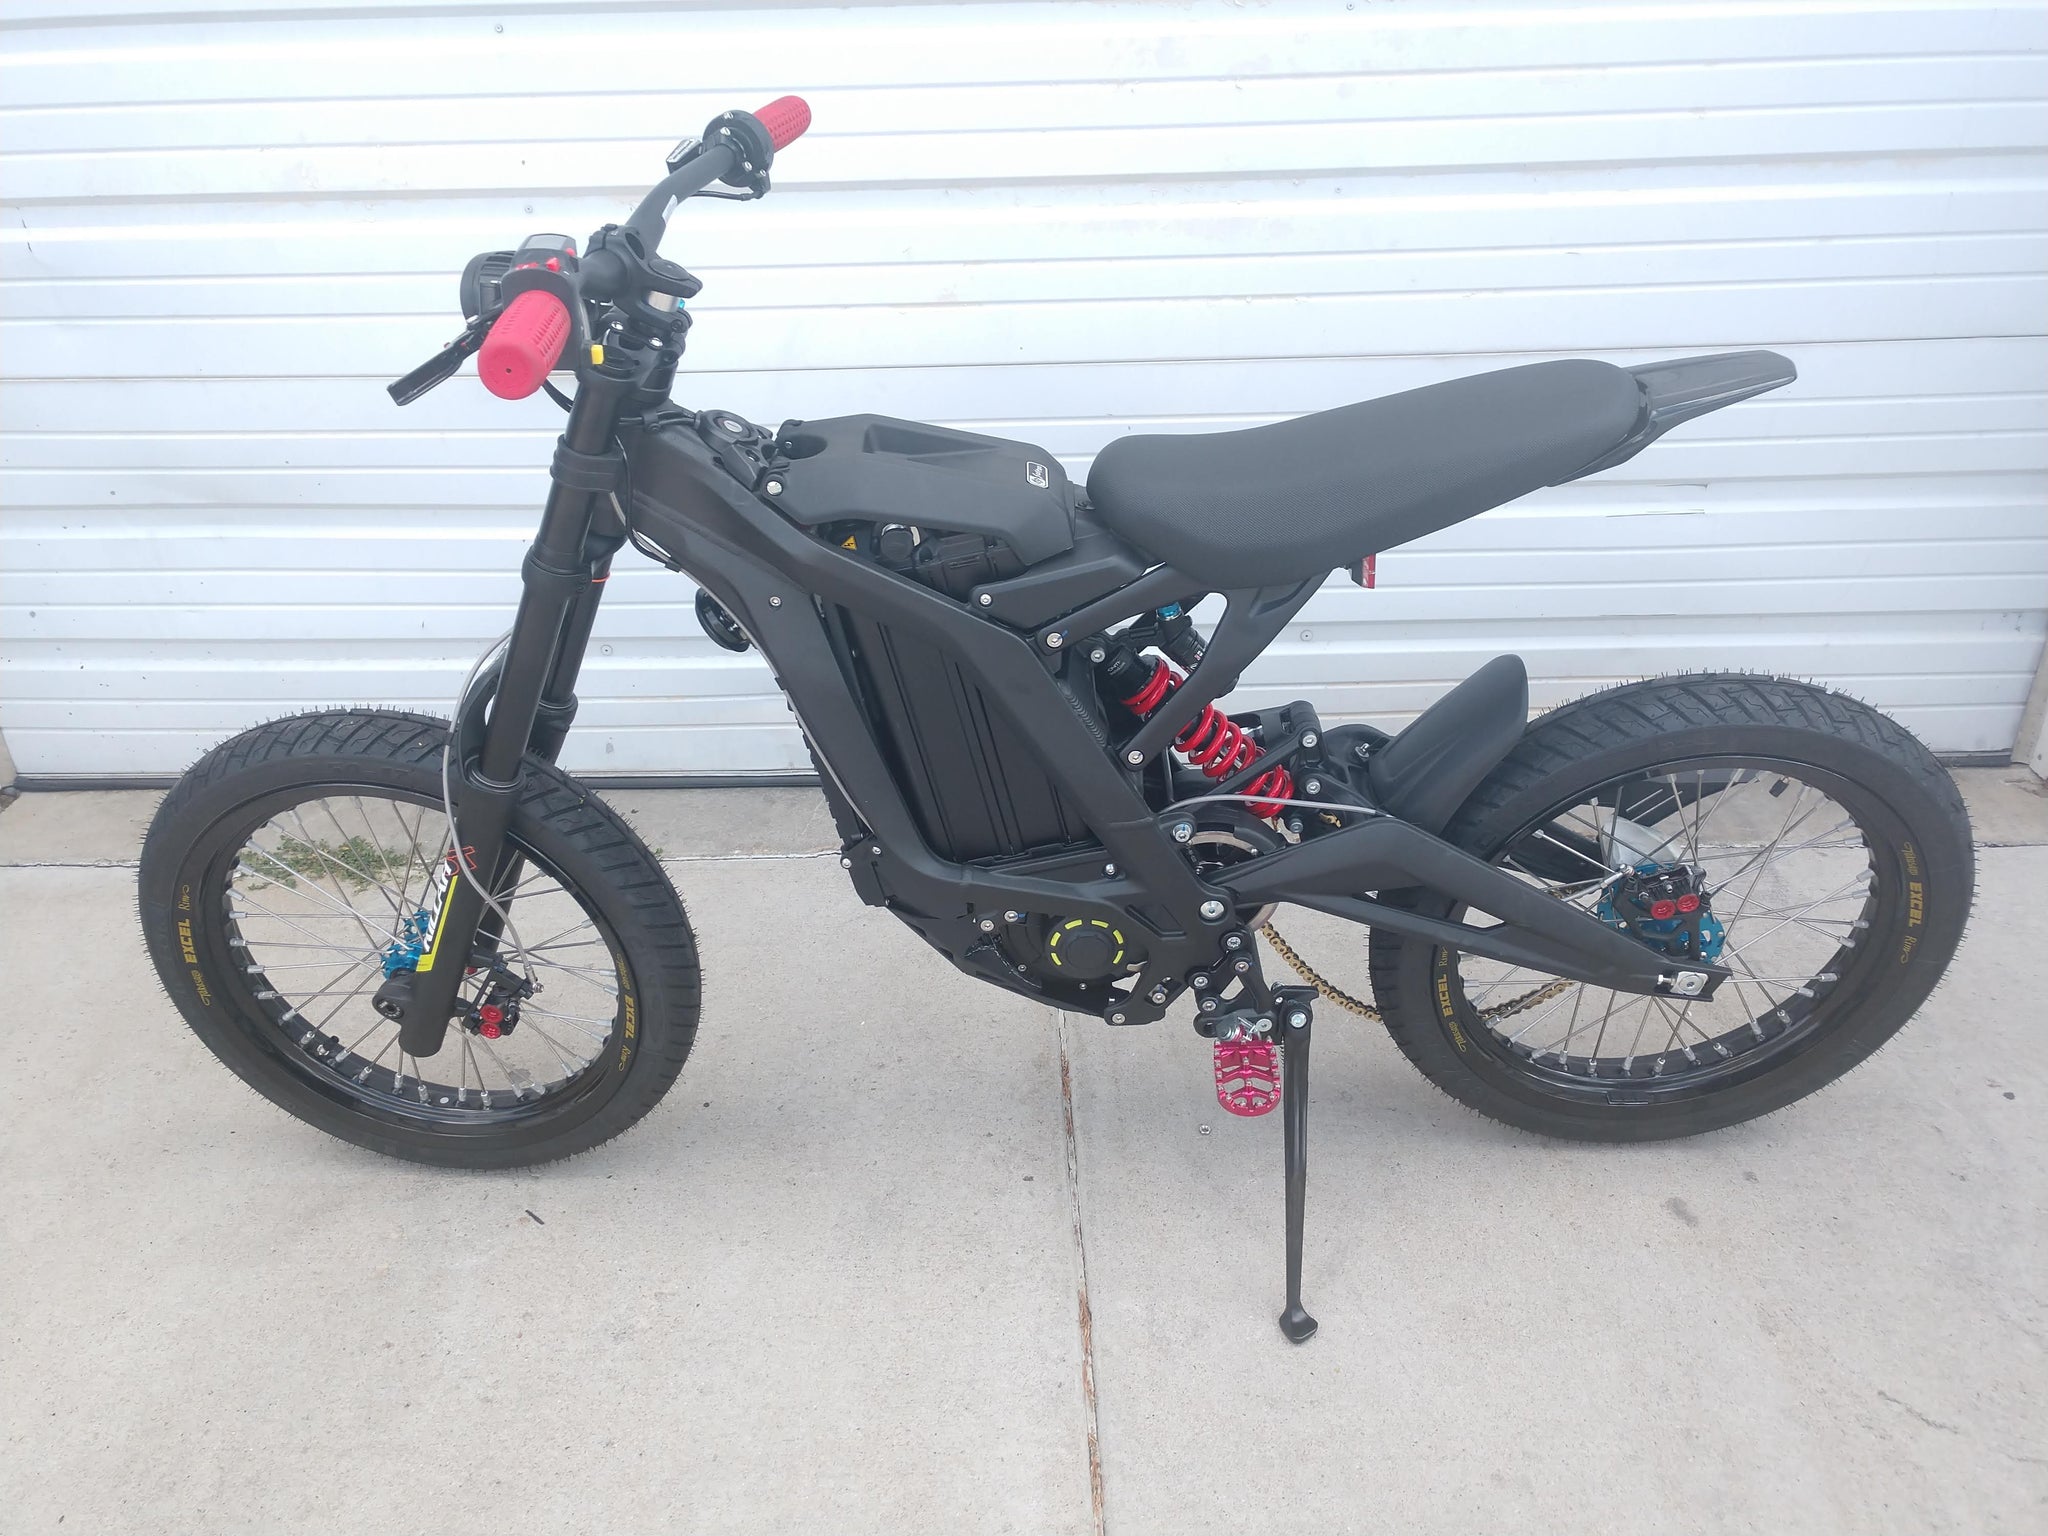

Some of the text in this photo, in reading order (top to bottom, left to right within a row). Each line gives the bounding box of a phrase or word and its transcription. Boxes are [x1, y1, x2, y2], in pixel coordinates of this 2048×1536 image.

[1908, 881, 1924, 928] EXCEL
[178, 918, 198, 964] EXCEL
[624, 995, 638, 1039] EXCEL
[1437, 973, 1454, 1018] EXCEL
